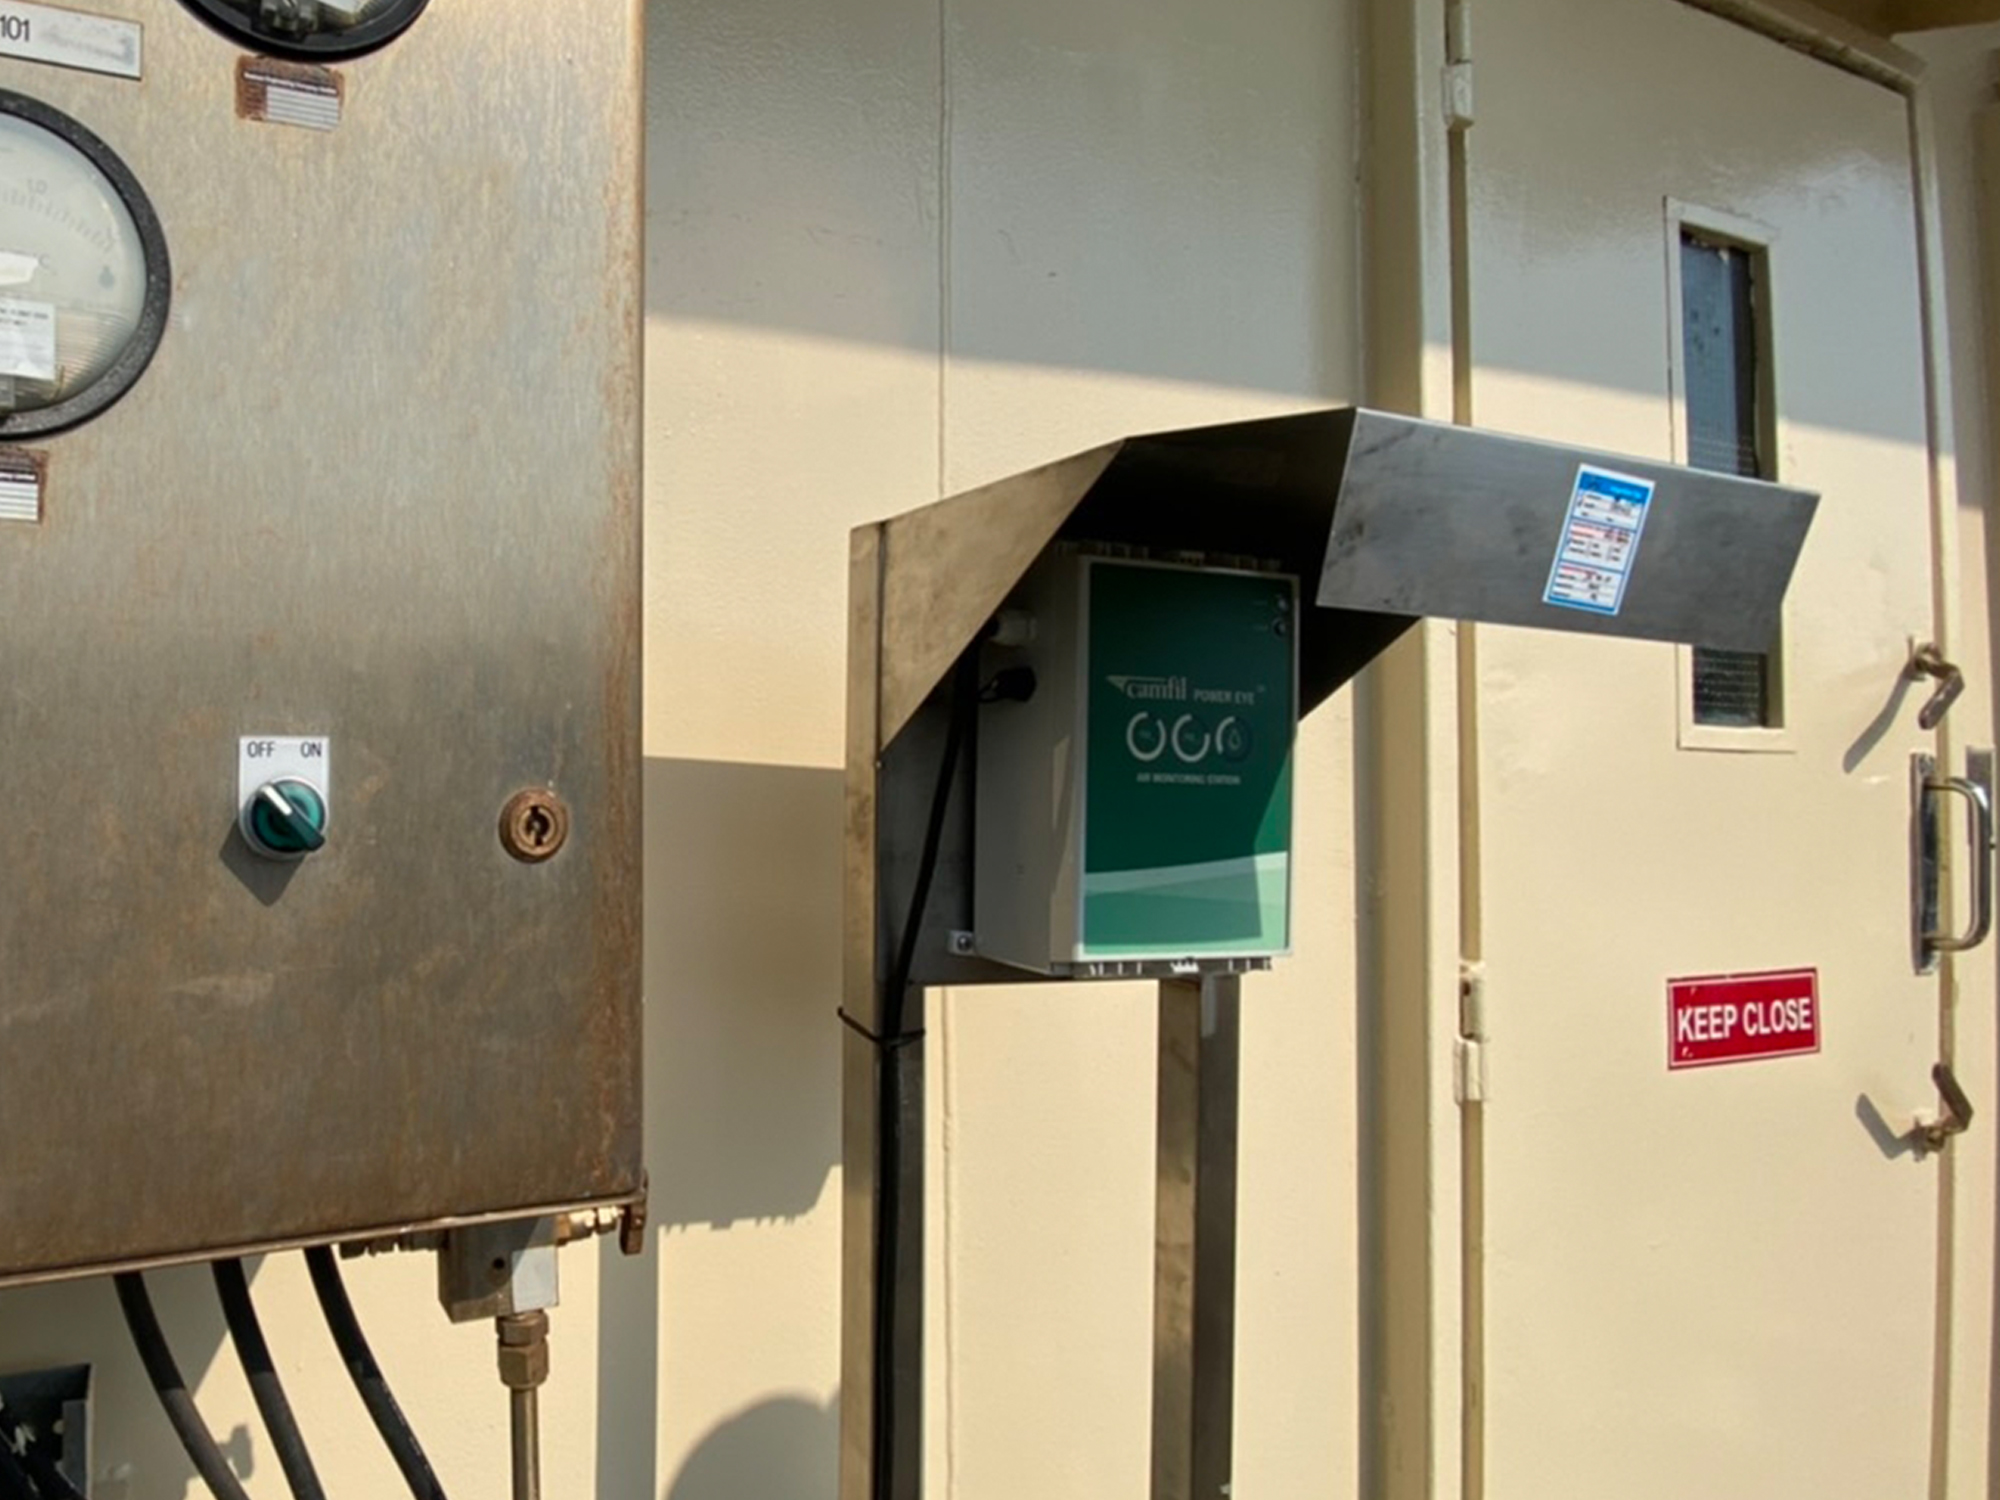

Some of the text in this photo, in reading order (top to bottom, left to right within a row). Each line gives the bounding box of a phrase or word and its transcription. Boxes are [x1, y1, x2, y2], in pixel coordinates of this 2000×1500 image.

[1126, 676, 1187, 700] camfil
[247, 741, 321, 758] OFF ON
[1677, 997, 1812, 1042] KEEP CLOSE
